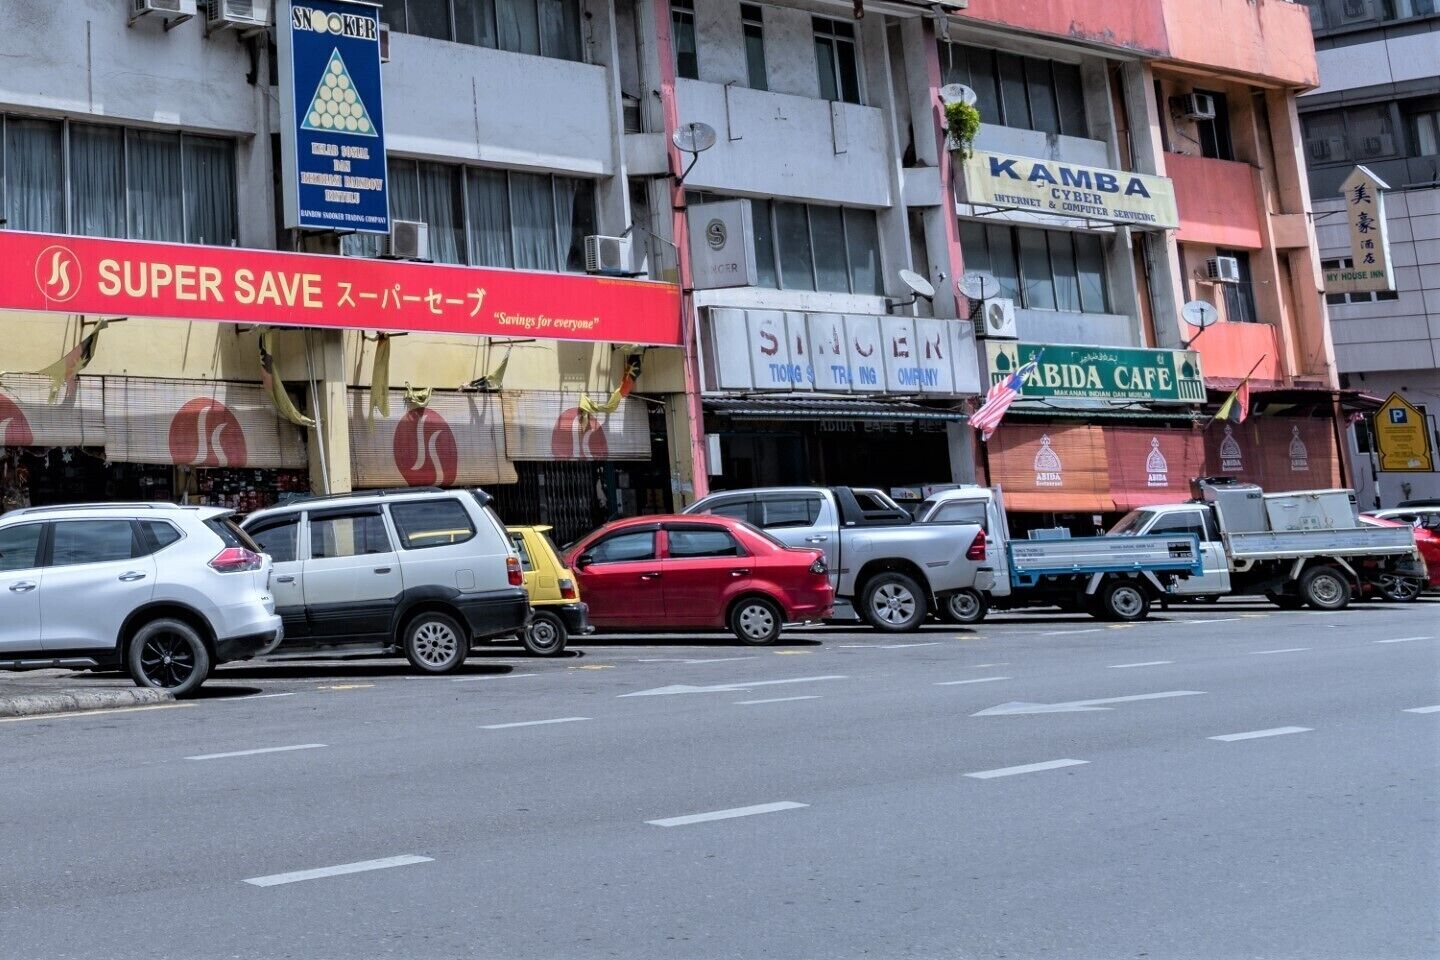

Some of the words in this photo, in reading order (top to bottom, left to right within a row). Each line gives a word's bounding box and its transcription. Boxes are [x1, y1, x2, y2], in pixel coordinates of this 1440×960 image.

[292, 6, 377, 40] SNOOKER
[989, 156, 1151, 199] KAMBA
[994, 194, 1041, 207] INTERNET
[1048, 200, 1056, 209] &
[1062, 203, 1108, 216] COMPUTER
[1113, 209, 1156, 223] SERVICING
[1051, 188, 1103, 205] CYBER
[300, 210, 321, 218] RAINBOW
[323, 212, 344, 220] SNOOKER
[345, 214, 364, 222] TRADING
[365, 215, 386, 224] COMPANY
[1351, 183, 1376, 264] 美豪酒店
[98, 258, 224, 303] SUPER
[234, 268, 323, 308] SAVE
[337, 282, 486, 317] スーパーセーブ
[1327, 272, 1338, 281] MY
[1341, 271, 1368, 281] HOUSE
[1370, 270, 1384, 279] INN
[537, 314, 552, 328] for
[769, 363, 802, 383] TIONG
[831, 365, 876, 385] TRAING
[898, 368, 938, 386] OMPANY
[1026, 363, 1103, 390] ABIDA
[1114, 365, 1172, 391] CAFE
